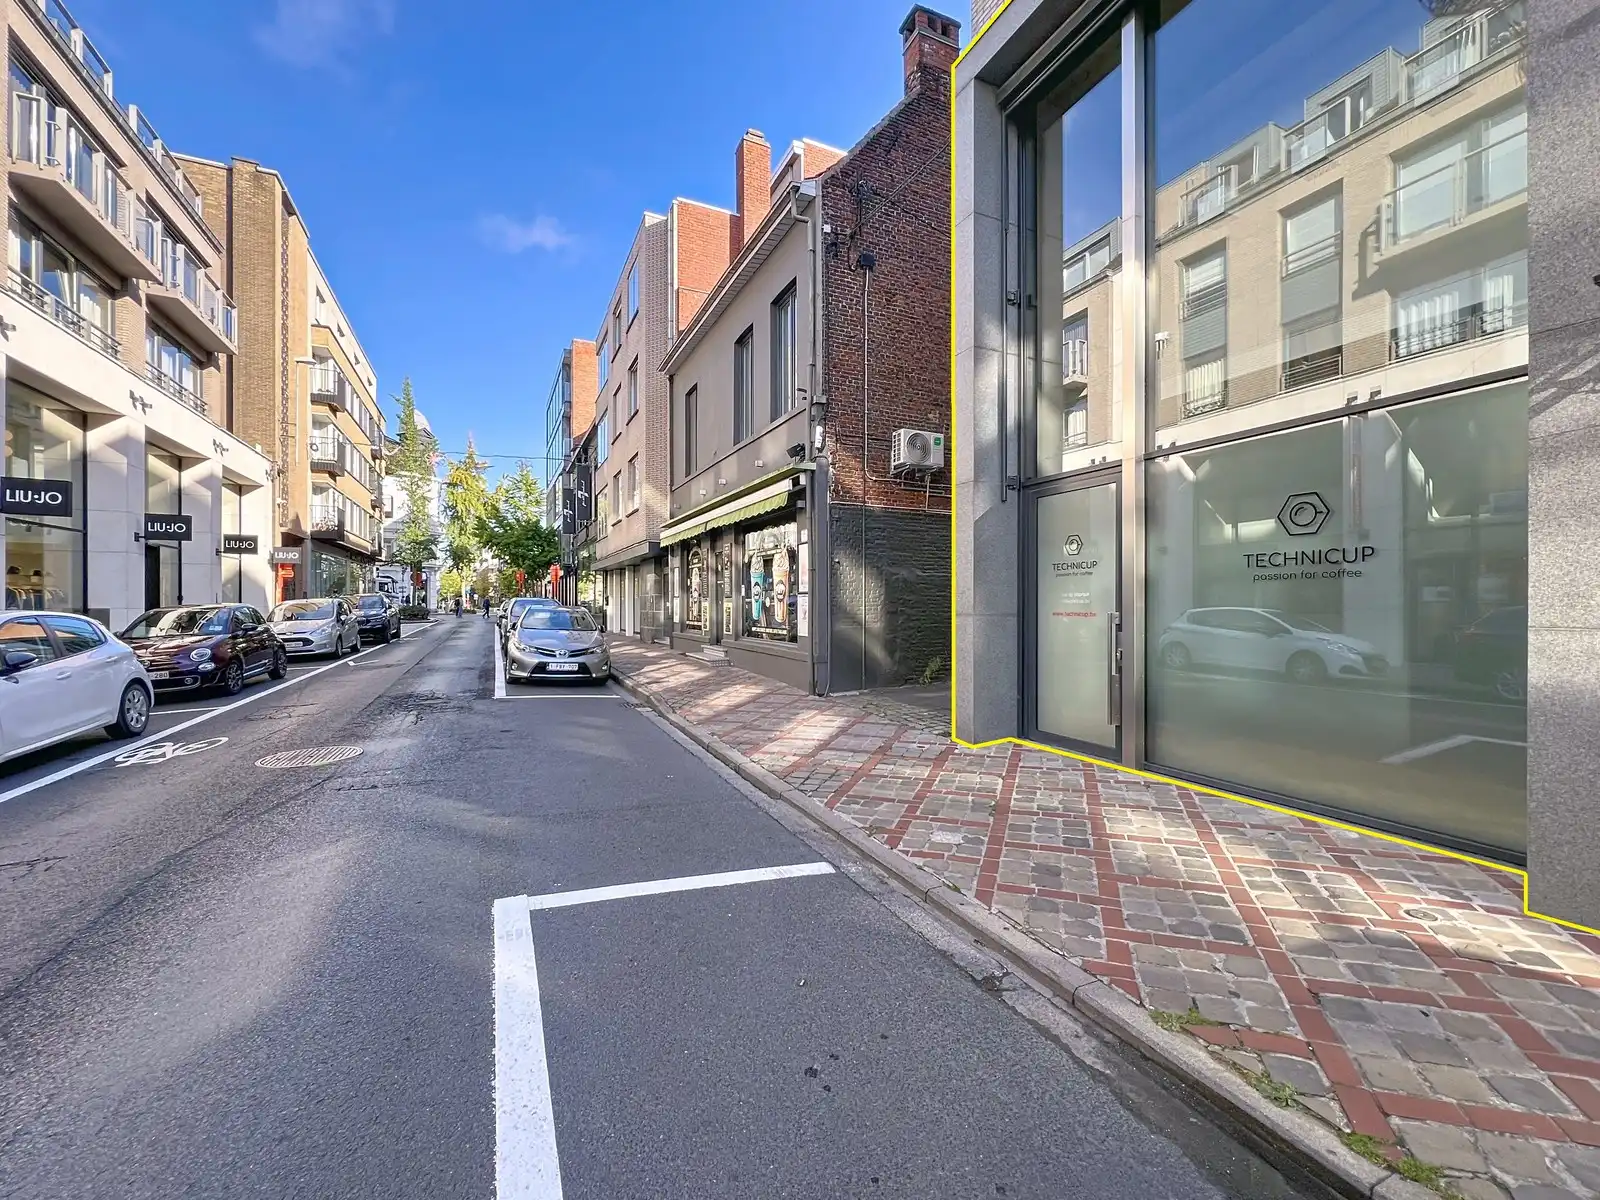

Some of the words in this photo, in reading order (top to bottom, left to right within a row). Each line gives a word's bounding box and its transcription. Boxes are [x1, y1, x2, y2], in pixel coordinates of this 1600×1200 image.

[1243, 546, 1375, 568] TECHNICUP
[1052, 560, 1097, 571] TECHNICUP
[1253, 571, 1297, 582] passion
[1300, 569, 1318, 580] for
[1321, 568, 1363, 579] coffee
